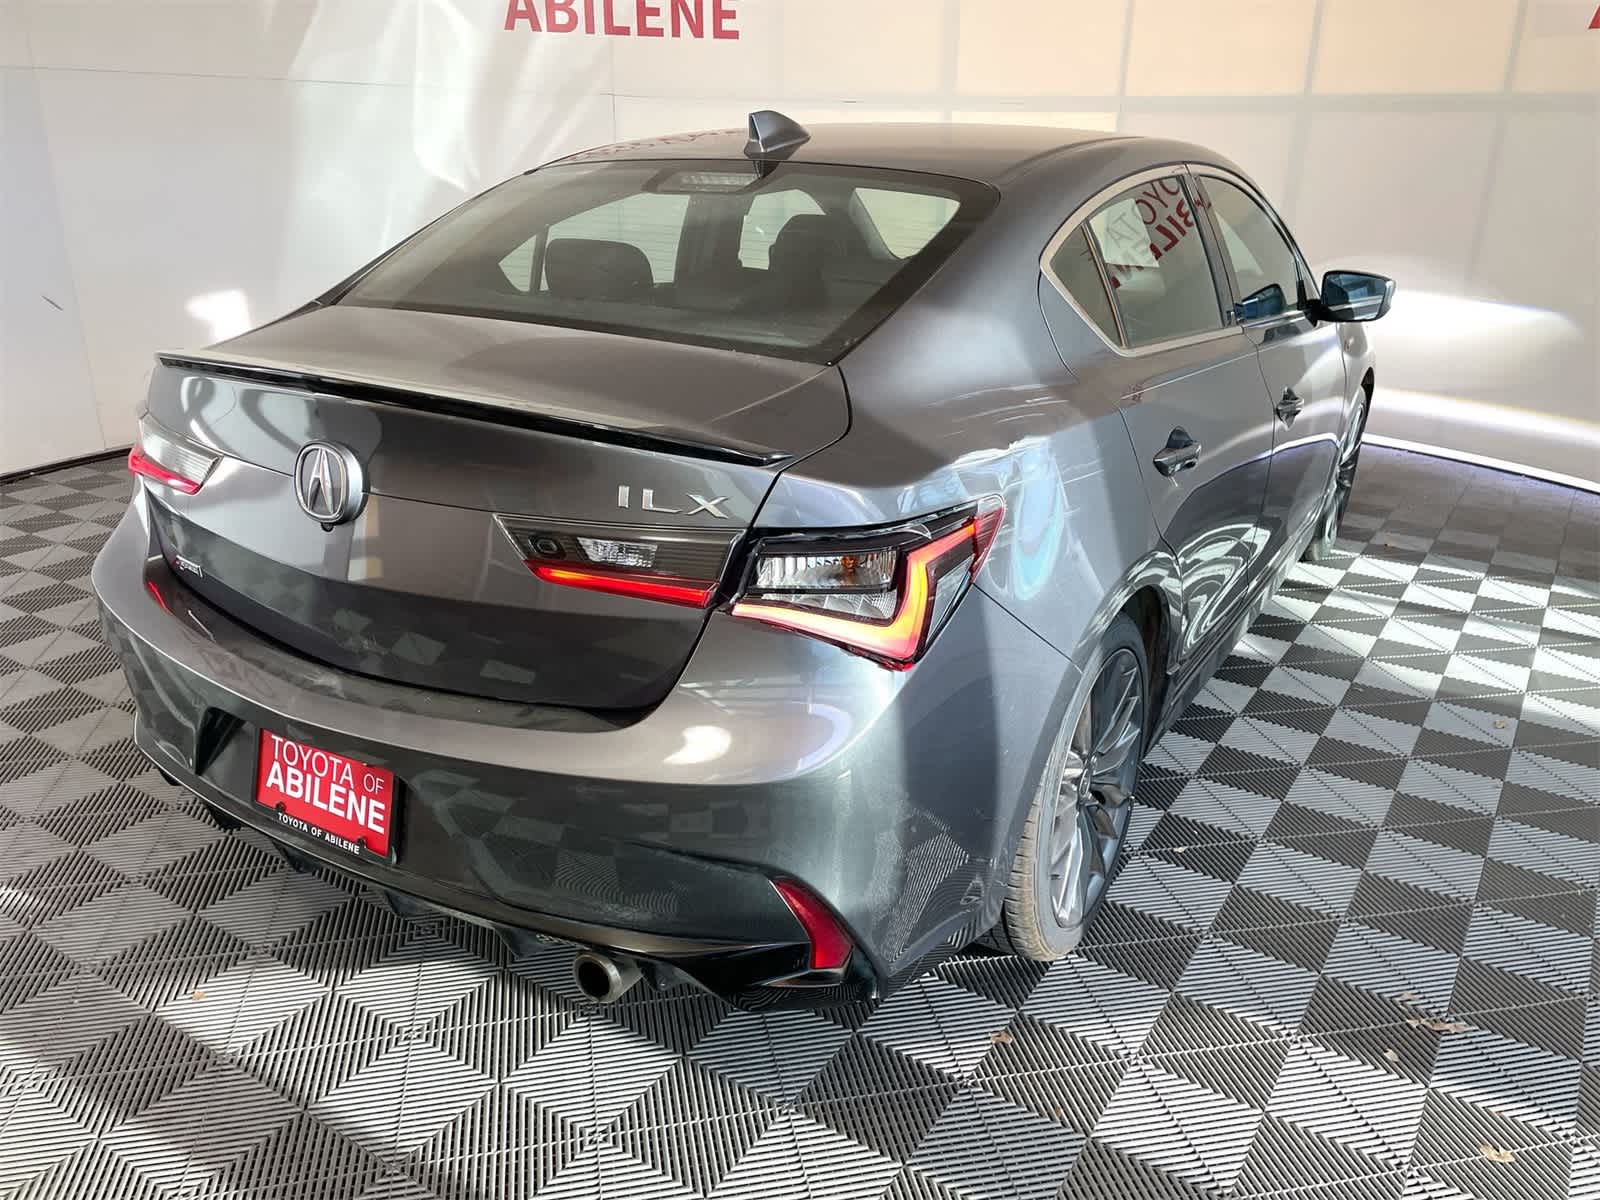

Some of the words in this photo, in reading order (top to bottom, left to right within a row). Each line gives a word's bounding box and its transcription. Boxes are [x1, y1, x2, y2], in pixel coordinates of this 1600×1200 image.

[504, 0, 740, 40] ABILENE
[618, 485, 729, 519] ILX
[271, 734, 355, 789] TOYOTA
[363, 773, 384, 795] OF
[266, 760, 386, 835] ABILENE
[278, 812, 308, 833] TOYOTA
[311, 827, 322, 838] OF
[324, 833, 360, 855] ABILENE
